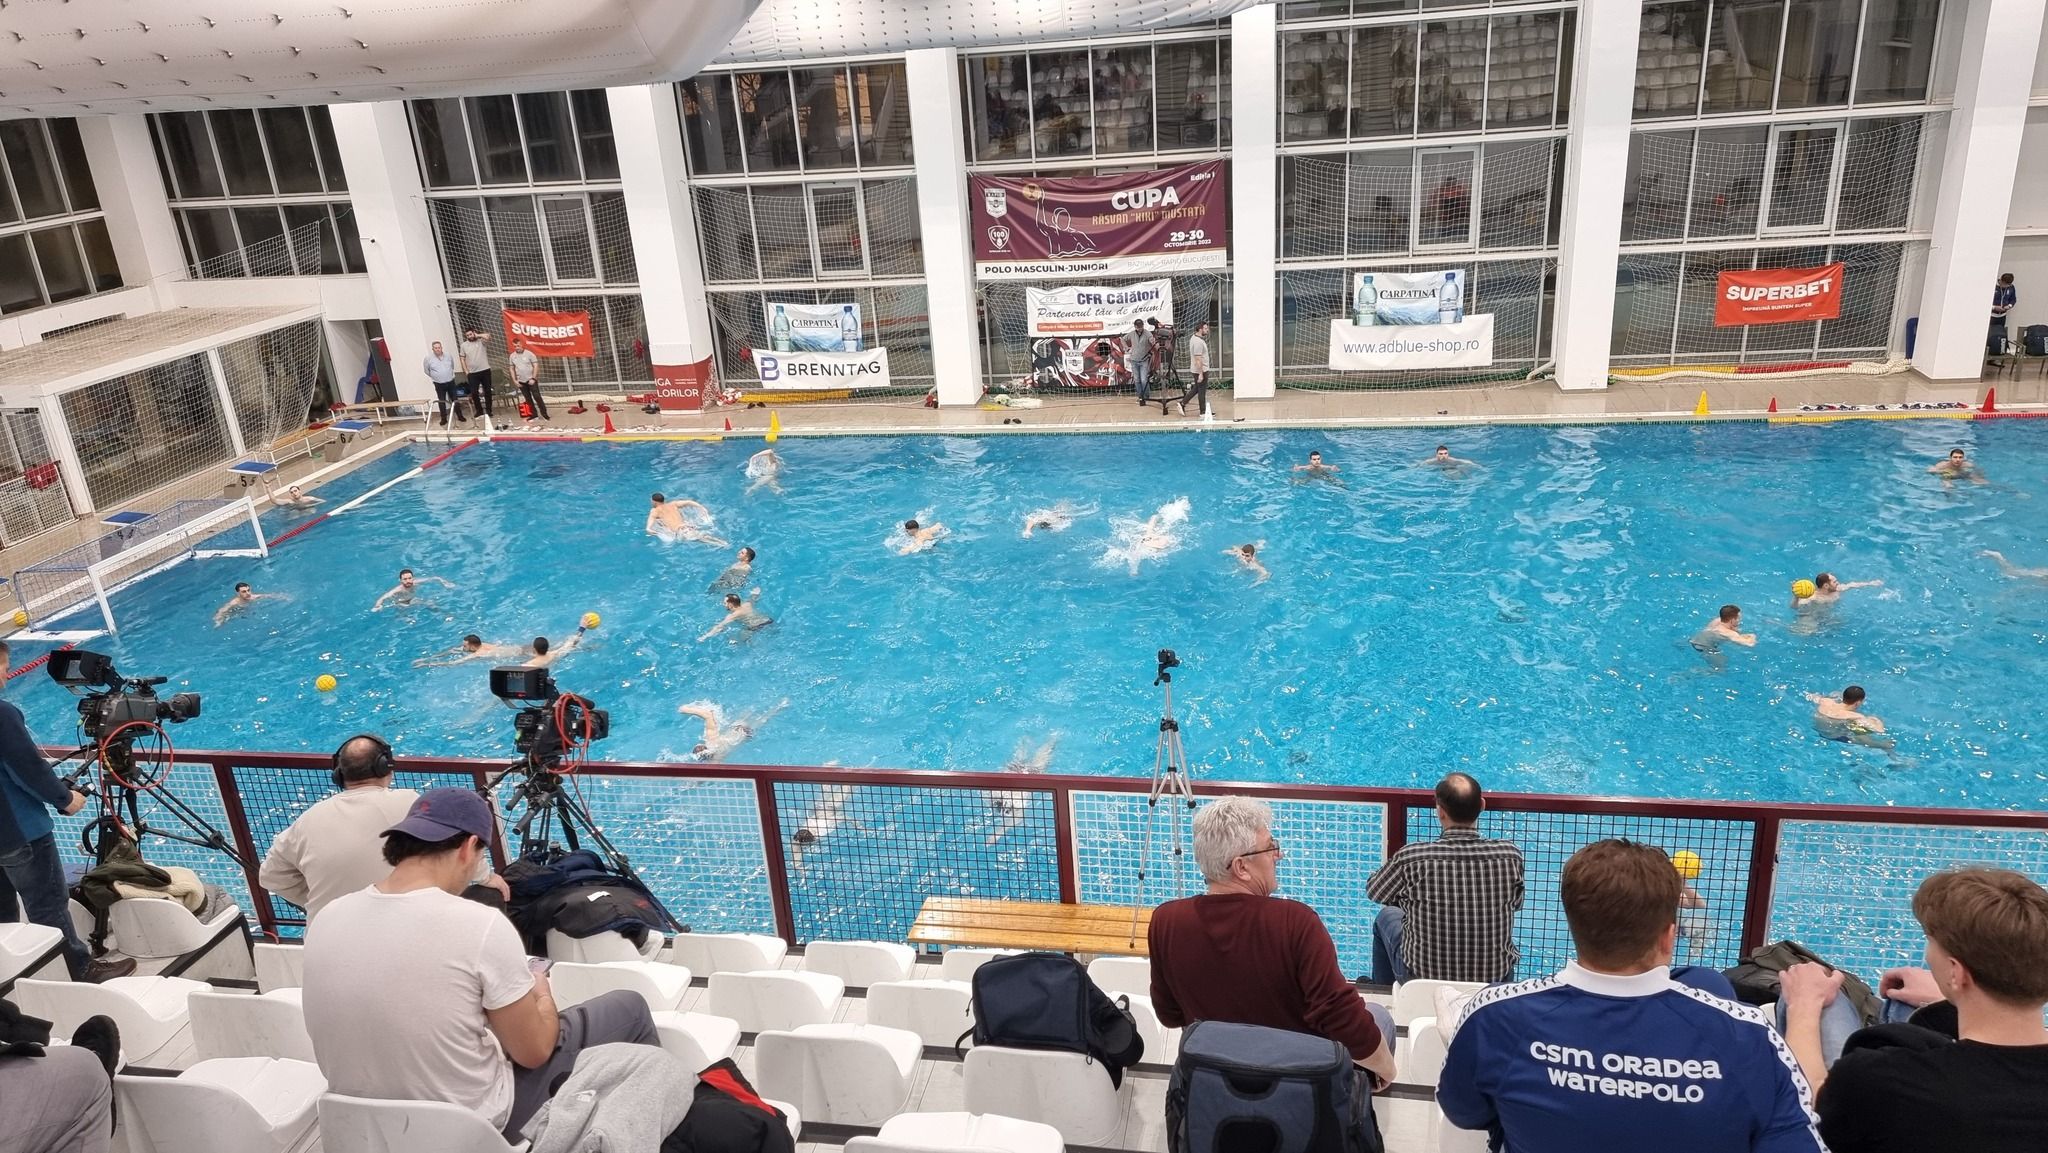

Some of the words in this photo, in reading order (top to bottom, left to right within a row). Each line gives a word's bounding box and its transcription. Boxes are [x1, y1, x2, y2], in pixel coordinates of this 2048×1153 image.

[1112, 186, 1180, 210] CUPA
[1170, 229, 1204, 242] 29-30
[1014, 263, 1108, 273] MASCULIN-JUNIORI
[1077, 293, 1102, 305] CFR
[1106, 288, 1160, 304] Călători
[1380, 288, 1436, 300] CARPATINA
[1726, 278, 1832, 300] SUPERBET
[1037, 308, 1092, 318] Partenerul
[1095, 308, 1112, 316] tău
[1116, 306, 1128, 315] de
[1132, 300, 1164, 314] drum!
[512, 322, 584, 339] SUPERBET
[791, 319, 840, 329] CARPATINA
[1344, 339, 1480, 354] www.adblue-shop.ro
[788, 361, 881, 376] BRENNTAG
[340, 433, 346, 444] 6
[241, 476, 247, 487] 5
